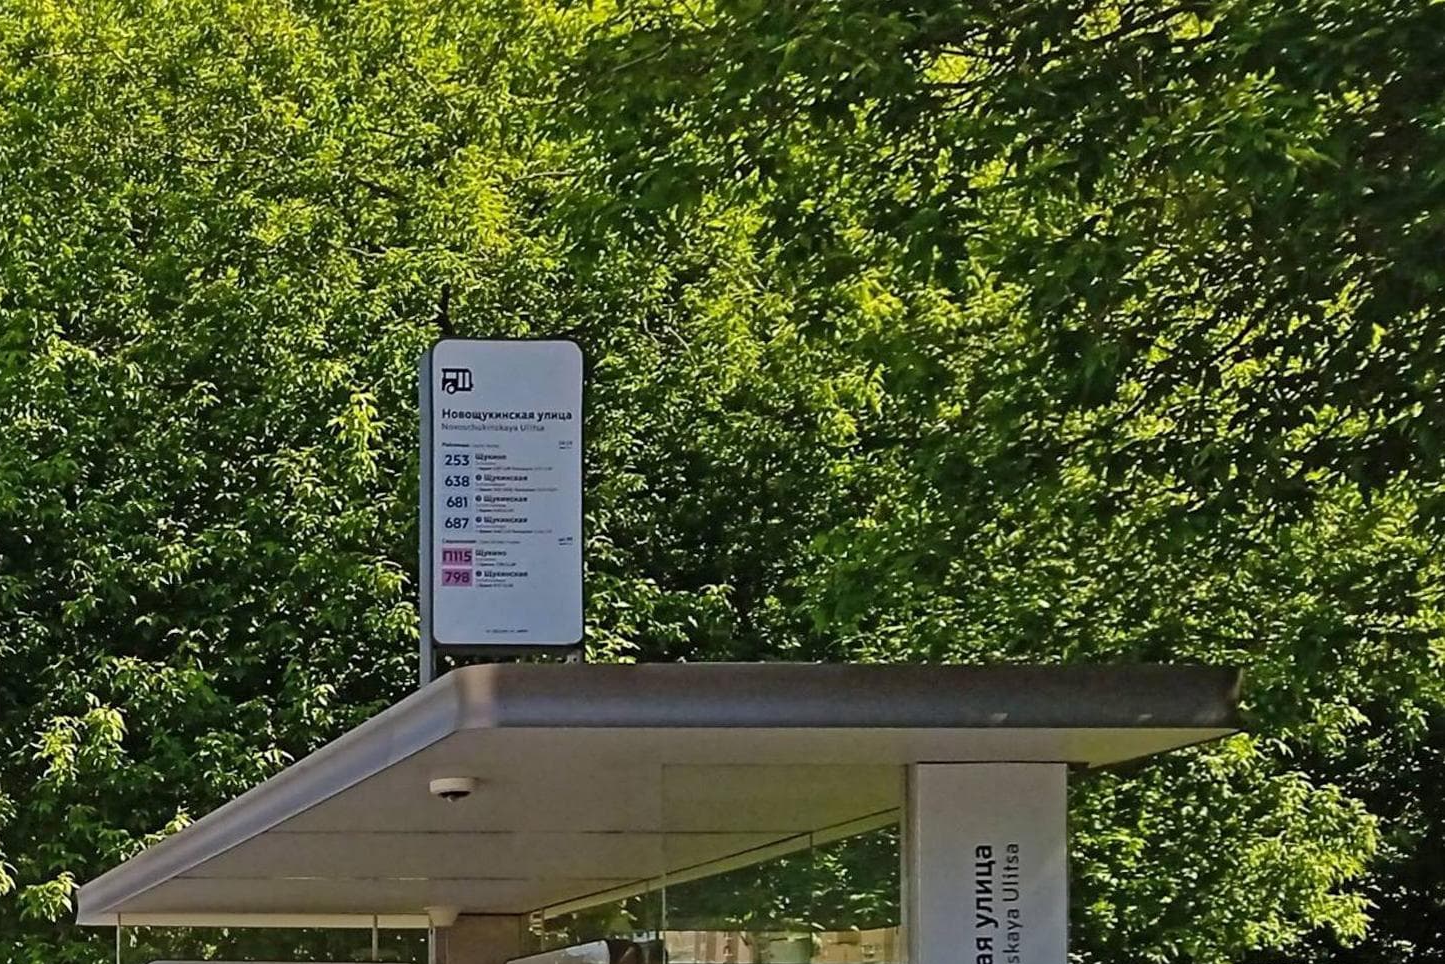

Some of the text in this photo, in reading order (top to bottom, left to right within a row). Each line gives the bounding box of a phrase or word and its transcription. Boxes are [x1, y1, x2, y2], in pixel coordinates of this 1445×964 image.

[442, 409, 572, 422] Новощукинская улица
[445, 455, 470, 466] 253
[445, 475, 470, 487] 638
[446, 496, 468, 508] 681
[445, 517, 470, 529] 687
[443, 550, 472, 562] П115
[445, 572, 470, 583] 798
[1002, 843, 1020, 902] Ulitsa
[975, 844, 999, 929] улица
